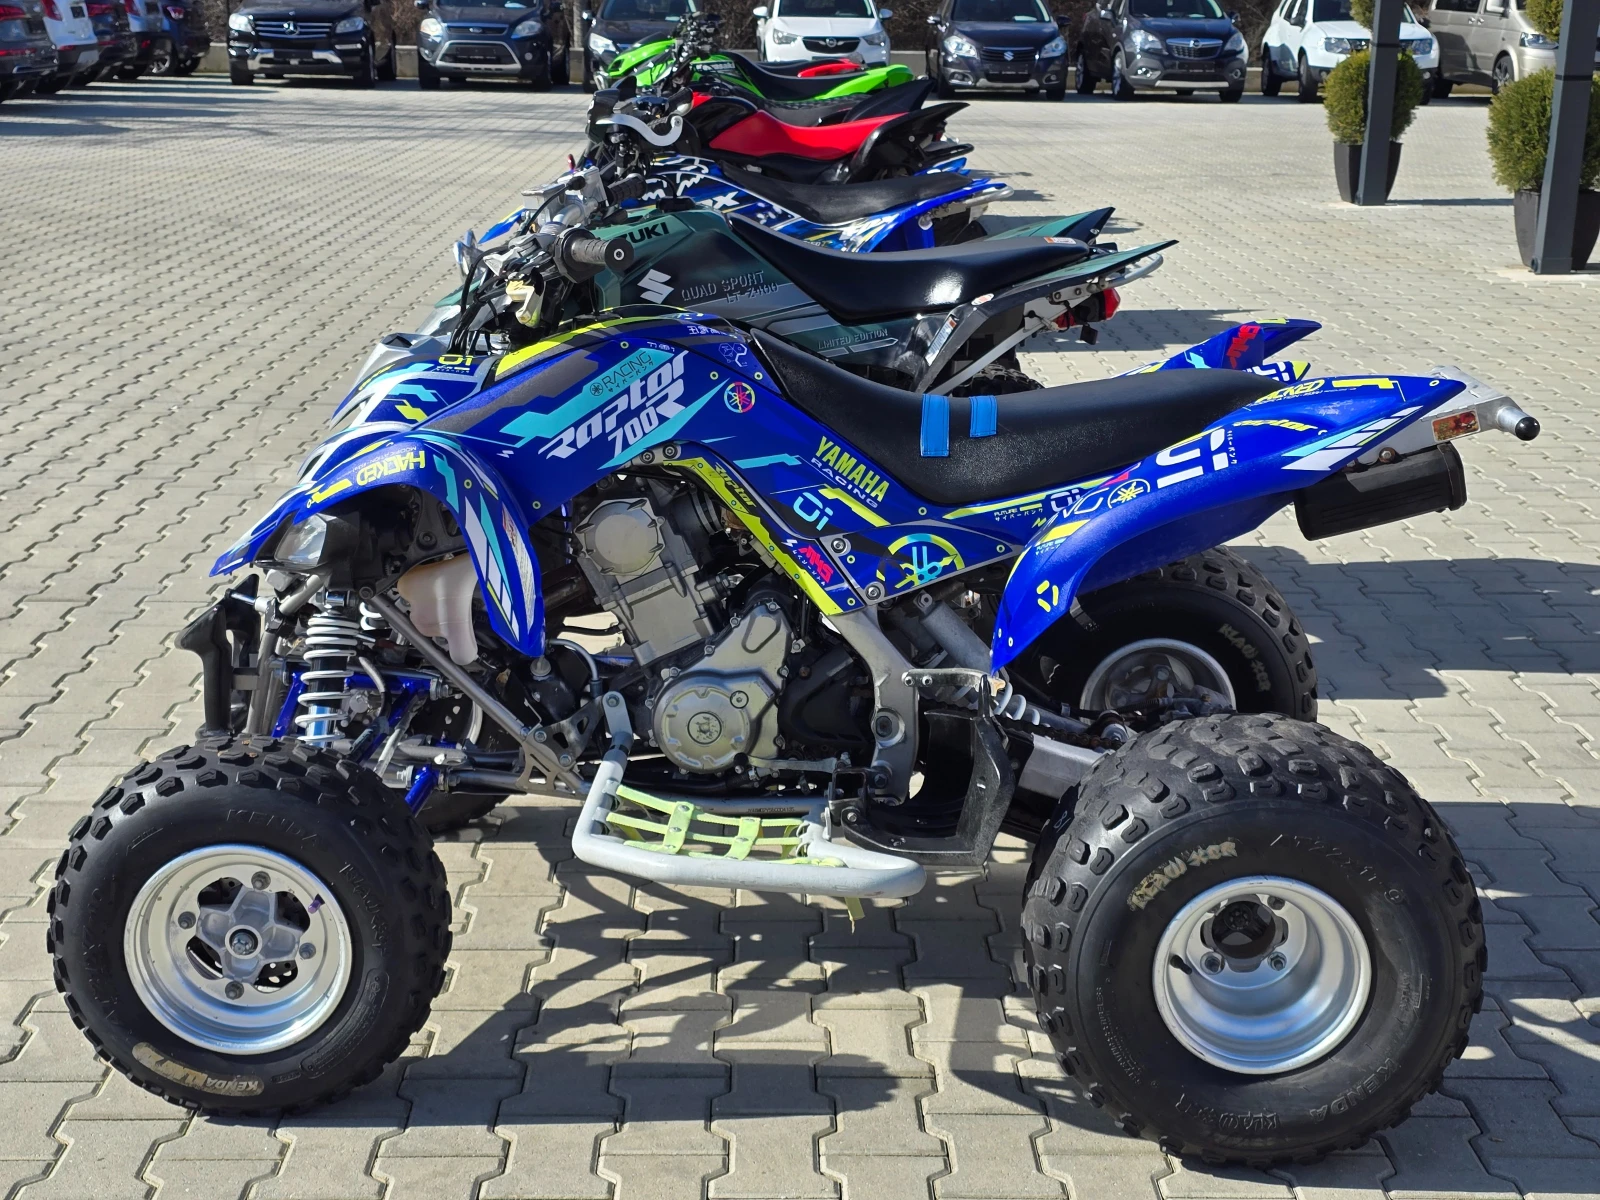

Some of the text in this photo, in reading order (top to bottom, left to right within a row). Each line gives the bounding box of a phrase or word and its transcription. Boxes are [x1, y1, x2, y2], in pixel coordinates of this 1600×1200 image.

[601, 351, 653, 389] RACING
[810, 457, 879, 508] RACING
[813, 436, 890, 503] YAMAHA
[206, 1077, 260, 1093] KENDA
